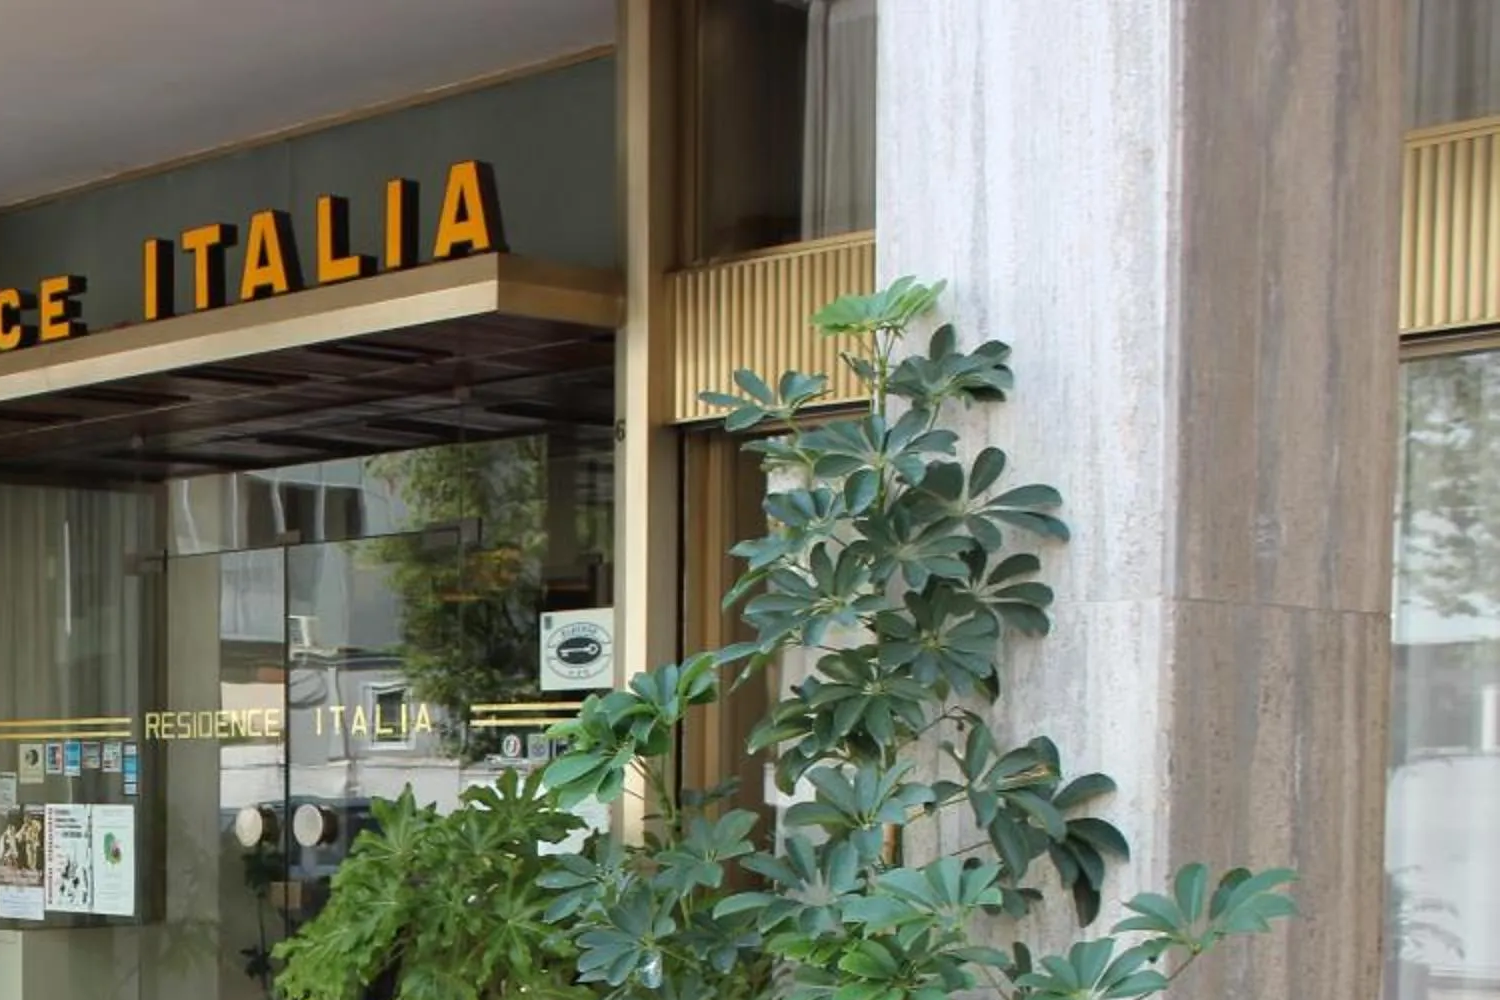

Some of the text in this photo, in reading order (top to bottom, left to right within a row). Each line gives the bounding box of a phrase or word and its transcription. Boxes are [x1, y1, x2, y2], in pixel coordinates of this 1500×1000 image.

[143, 159, 496, 321] ITALIA
[144, 702, 433, 740] RESIDENCE ITALIA
